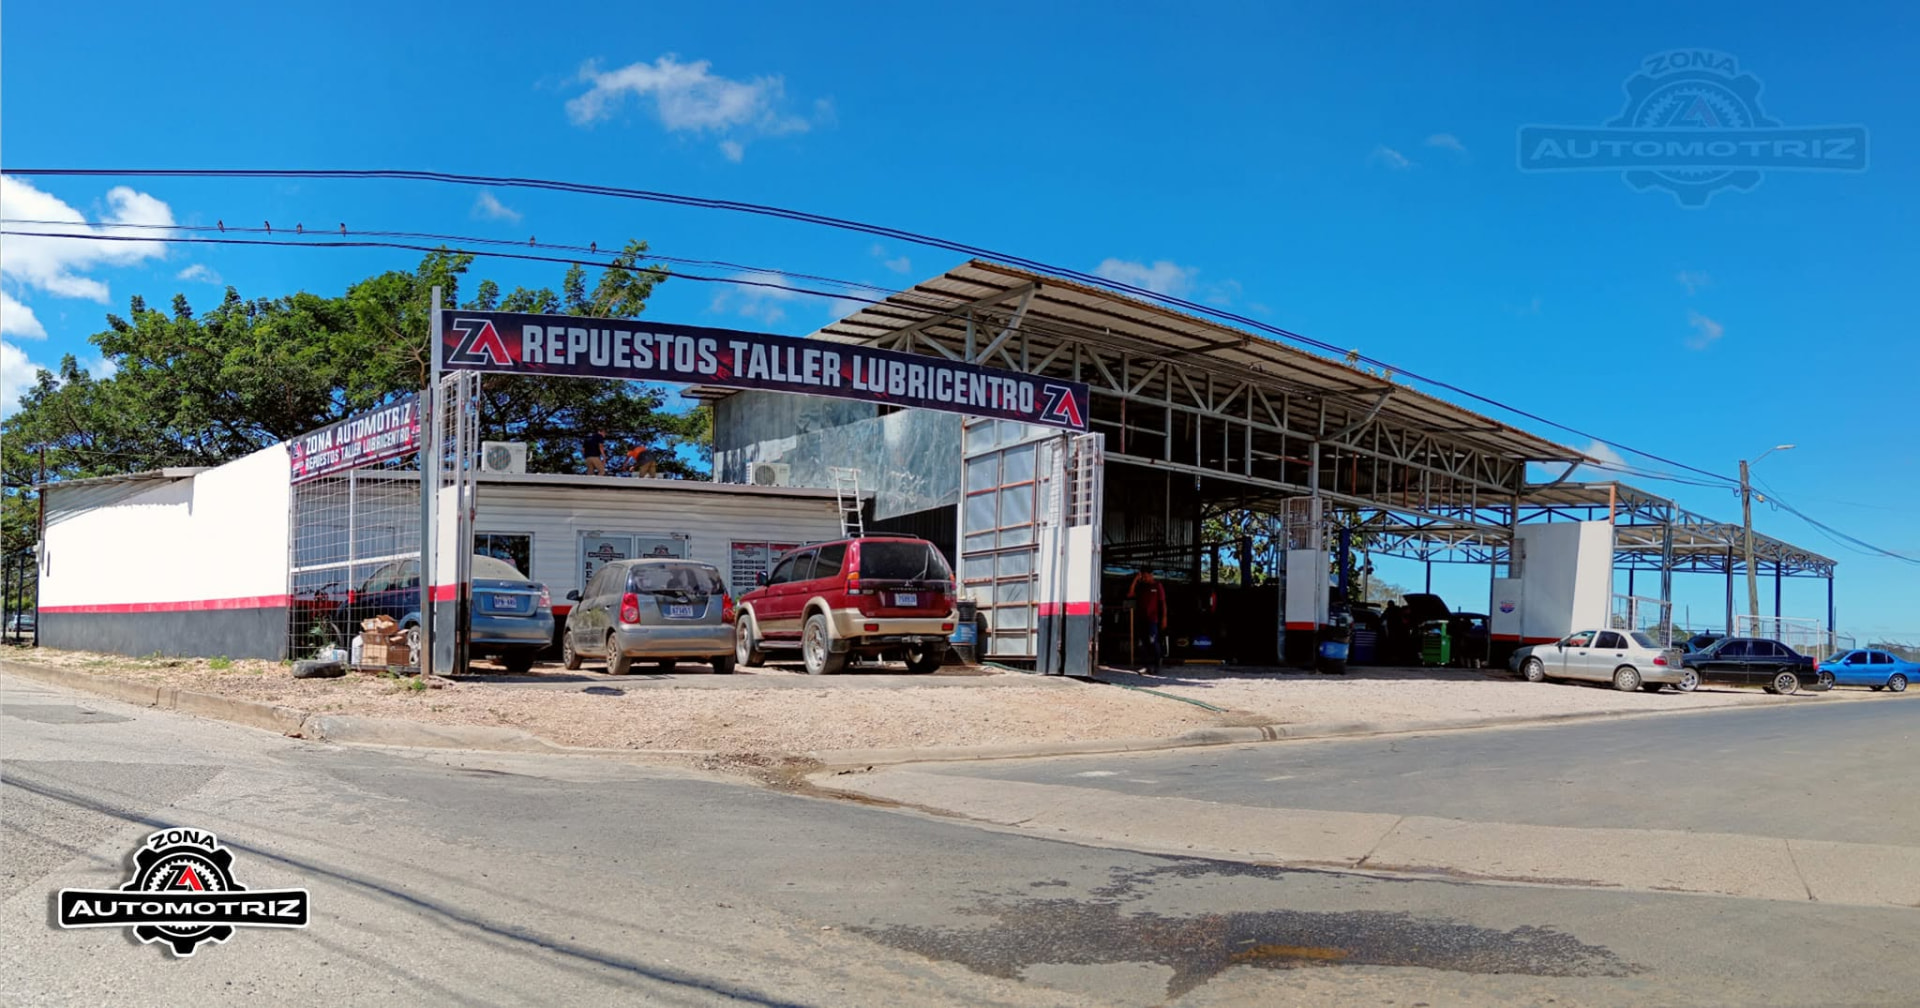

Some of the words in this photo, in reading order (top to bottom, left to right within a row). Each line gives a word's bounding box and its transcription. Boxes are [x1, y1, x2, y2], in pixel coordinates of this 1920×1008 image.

[522, 324, 717, 375] REPUESTOS
[729, 340, 840, 387] TALLER
[852, 355, 1034, 413] LUBRICENTRO
[305, 430, 333, 456] ZONA
[336, 403, 411, 445] AUTOMOTRIZ
[305, 449, 340, 471] REPUESTOS
[341, 439, 361, 460] TALLER
[362, 426, 410, 454] LUBRICENTRO
